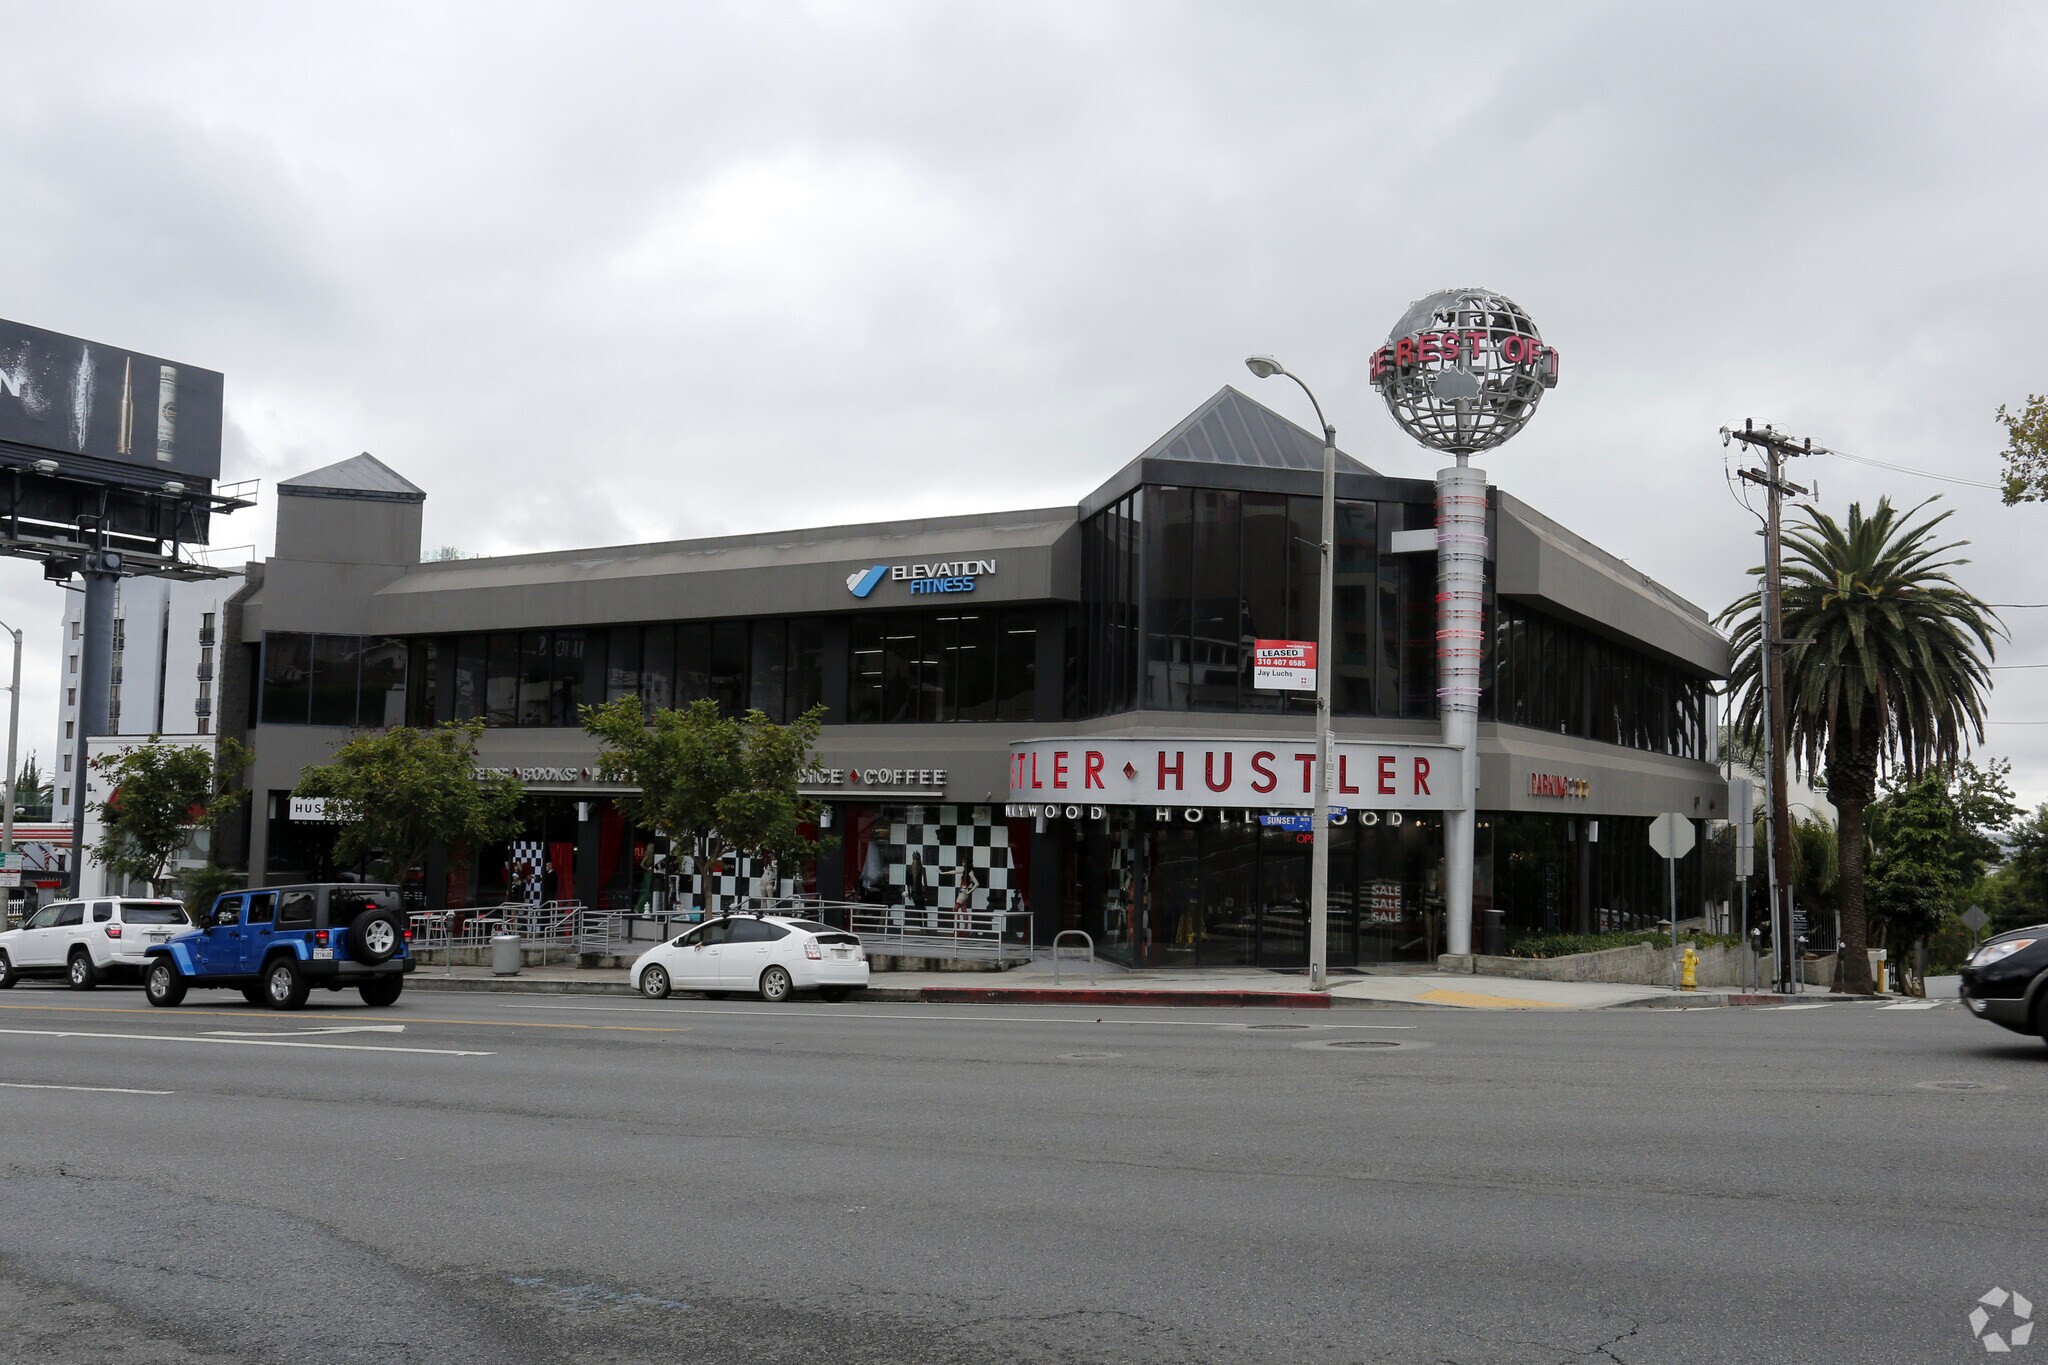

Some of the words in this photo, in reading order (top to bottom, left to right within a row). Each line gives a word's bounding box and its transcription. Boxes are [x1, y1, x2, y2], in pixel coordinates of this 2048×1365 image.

[1396, 331, 1488, 366] REST
[1504, 335, 1543, 365] OF
[891, 559, 996, 581] ELEVATION
[910, 576, 976, 594] FITNESS
[1257, 669, 1270, 677] Jay
[522, 767, 577, 781] BOOKS
[864, 768, 947, 785] COFFEE
[1157, 751, 1431, 795] HUSTLER
[1531, 773, 1568, 798] PARKING
[1267, 816, 1296, 825] SUNSET
[1372, 885, 1401, 896] SALE
[1372, 898, 1401, 909] SALE
[1372, 911, 1401, 922] SALE
